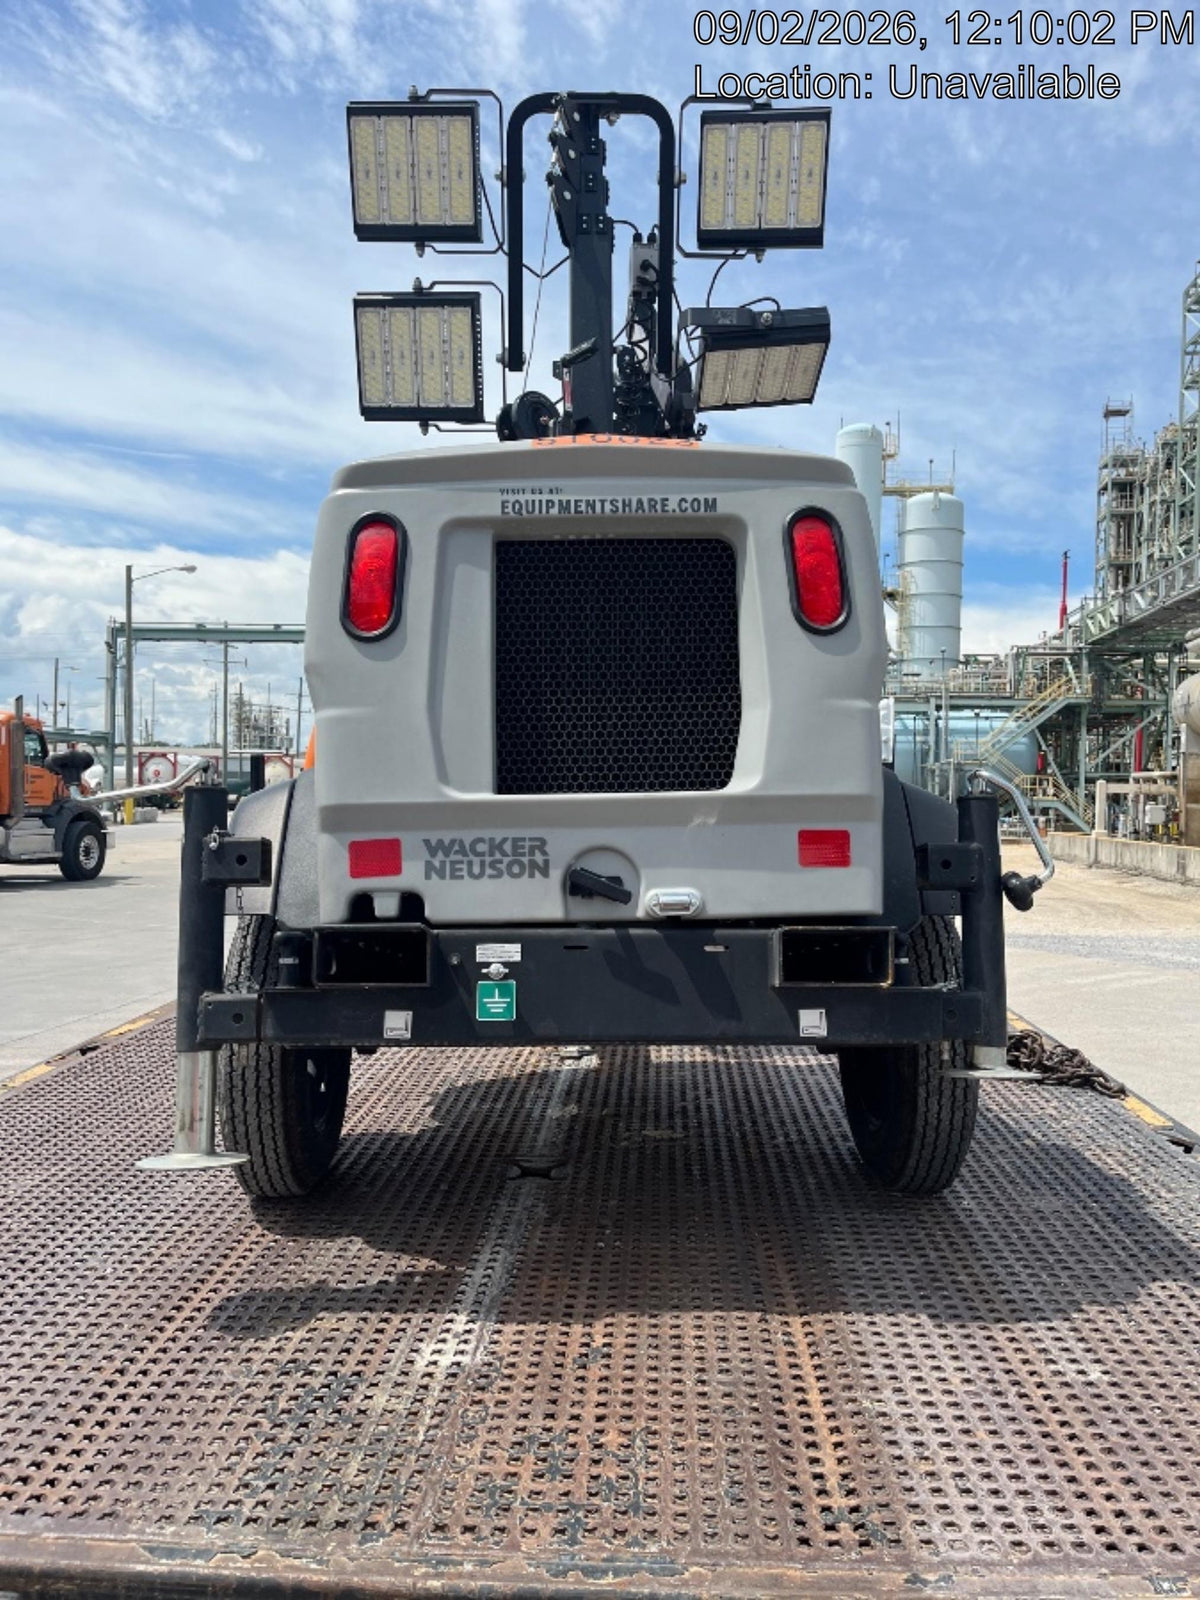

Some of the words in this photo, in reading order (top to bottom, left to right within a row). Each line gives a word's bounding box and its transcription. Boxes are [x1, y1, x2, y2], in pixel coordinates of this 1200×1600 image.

[499, 487, 526, 496] VISIT
[500, 497, 718, 517] EQUIPMENTSHARE.COM
[422, 836, 549, 859] WACKER
[424, 858, 550, 881] NEUSON
